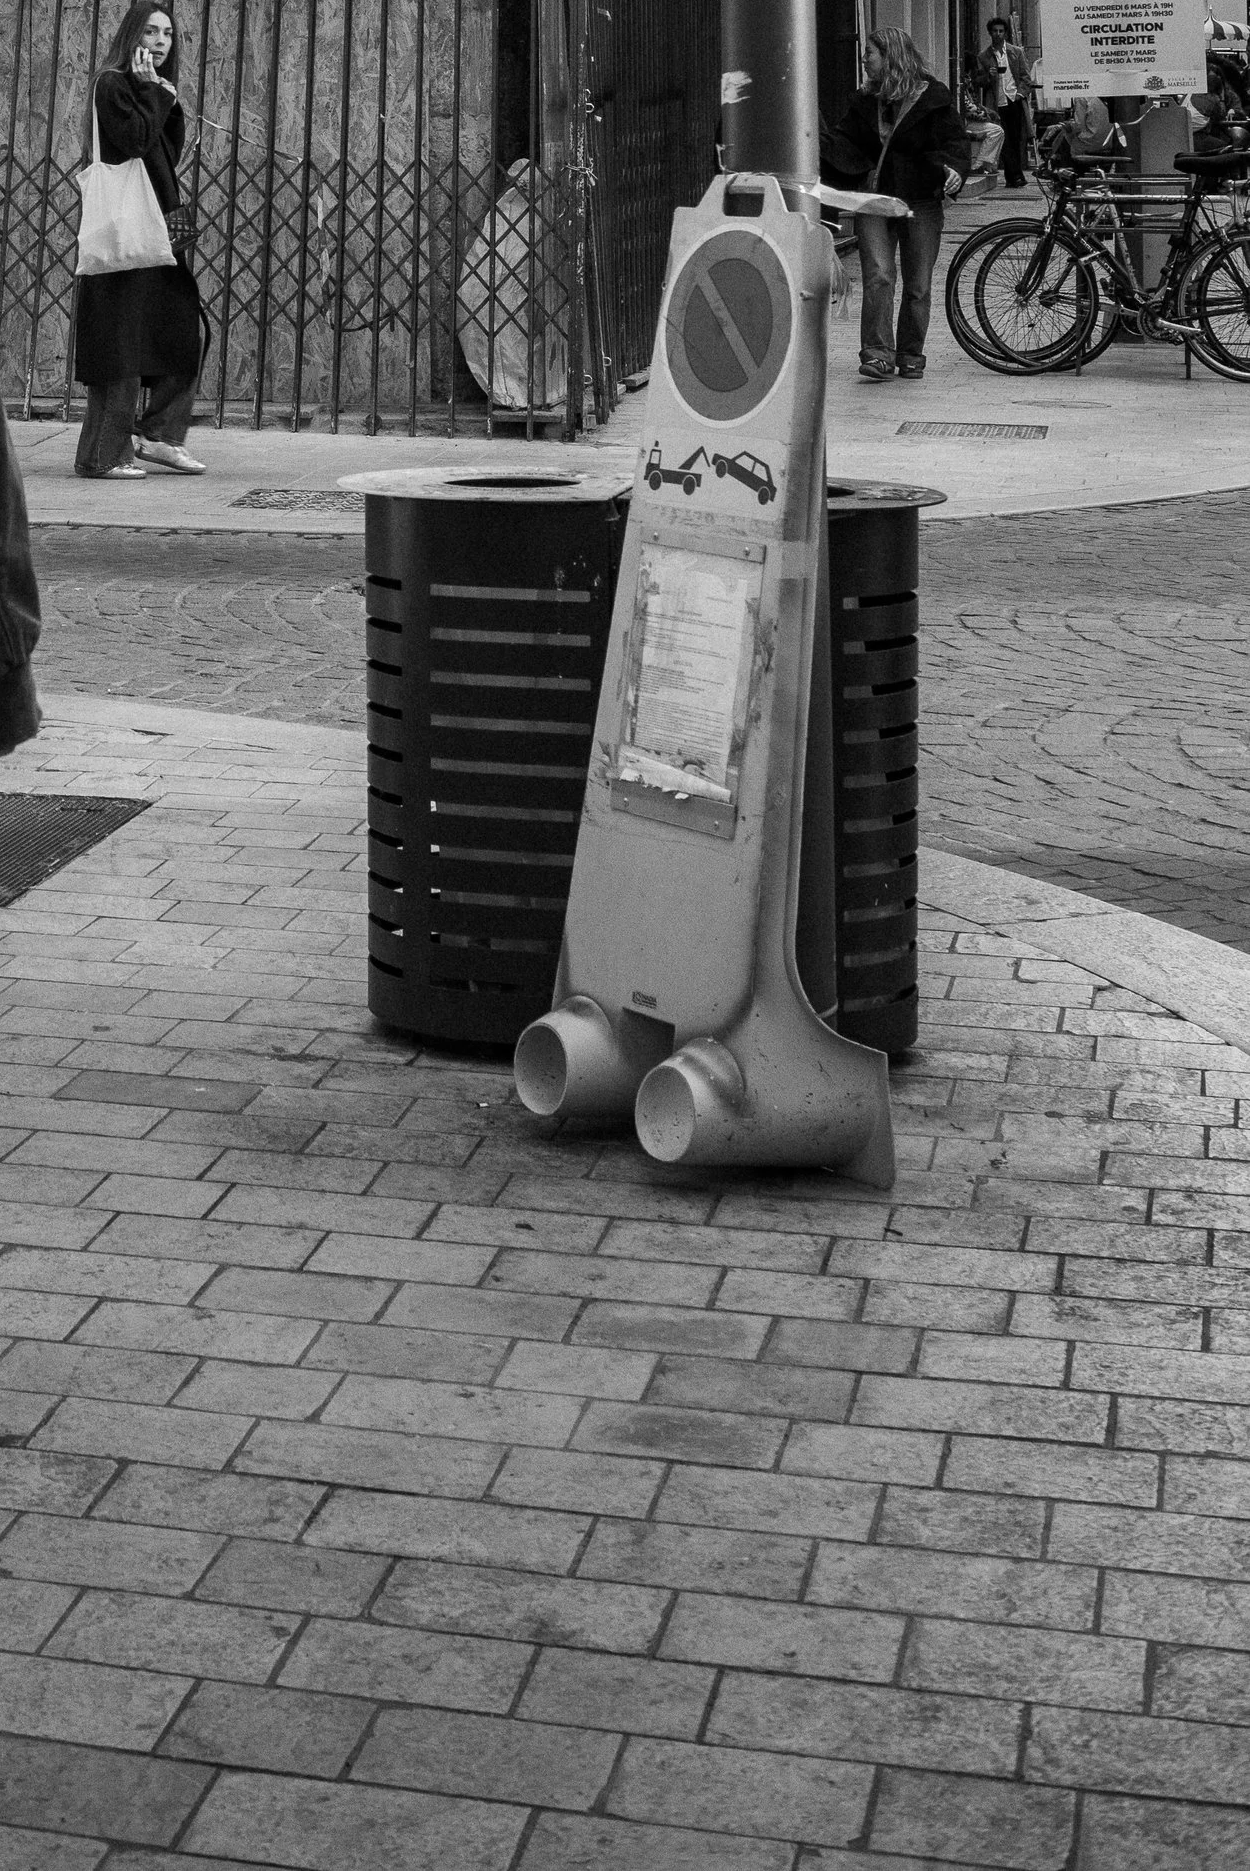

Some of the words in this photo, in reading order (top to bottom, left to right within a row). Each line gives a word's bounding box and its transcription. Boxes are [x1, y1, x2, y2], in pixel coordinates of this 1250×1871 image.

[1080, 22, 1164, 34] CIRCULATION
[1090, 35, 1155, 46] INTERDITE
[1126, 56, 1132, 64] À
